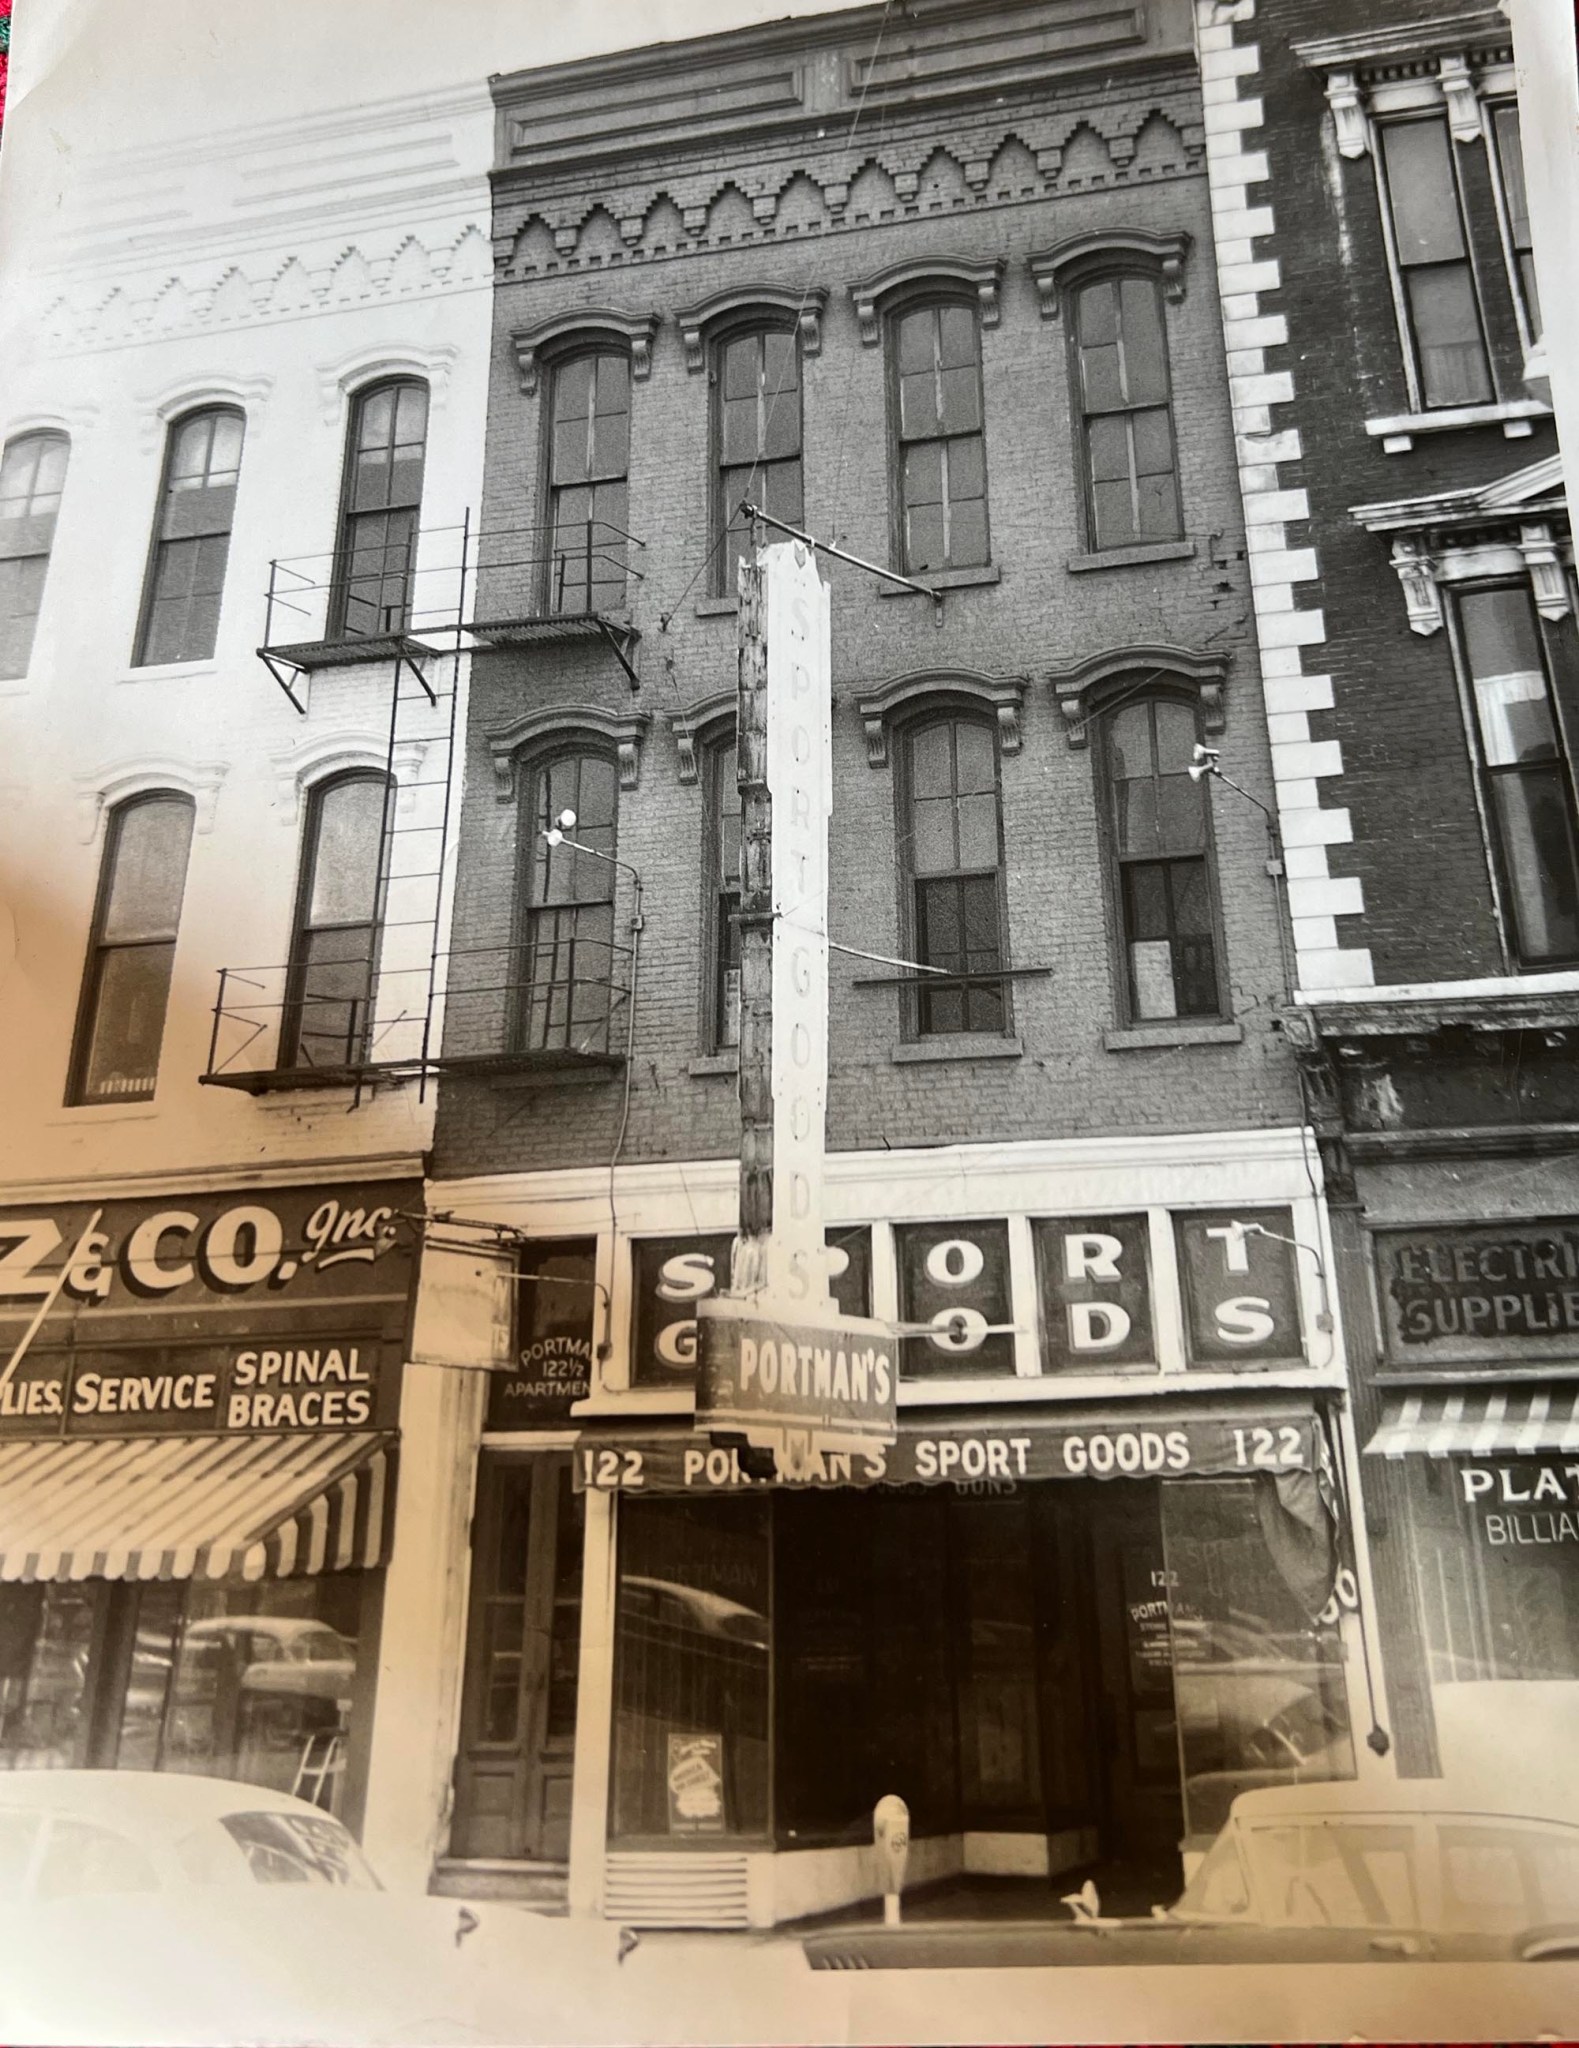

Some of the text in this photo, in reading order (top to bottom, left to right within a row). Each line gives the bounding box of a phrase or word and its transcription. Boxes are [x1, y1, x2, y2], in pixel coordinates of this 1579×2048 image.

[790, 596, 811, 895] SPORT
[790, 946, 811, 1299] GOODS
[127, 1205, 299, 1292] CO.
[656, 1296, 1275, 1364] GODS
[73, 1372, 217, 1414] SERVICE
[234, 1347, 370, 1387] SPINAL
[740, 1338, 892, 1405] PORTMAN'S
[228, 1389, 370, 1429] BRACES
[583, 1449, 644, 1486] 122
[915, 1438, 1031, 1478] SPORT
[1063, 1431, 1190, 1474] GOODS
[1233, 1426, 1305, 1467] 122
[1486, 1511, 1579, 1545] BILLIA
[1150, 1570, 1181, 1588] 122
